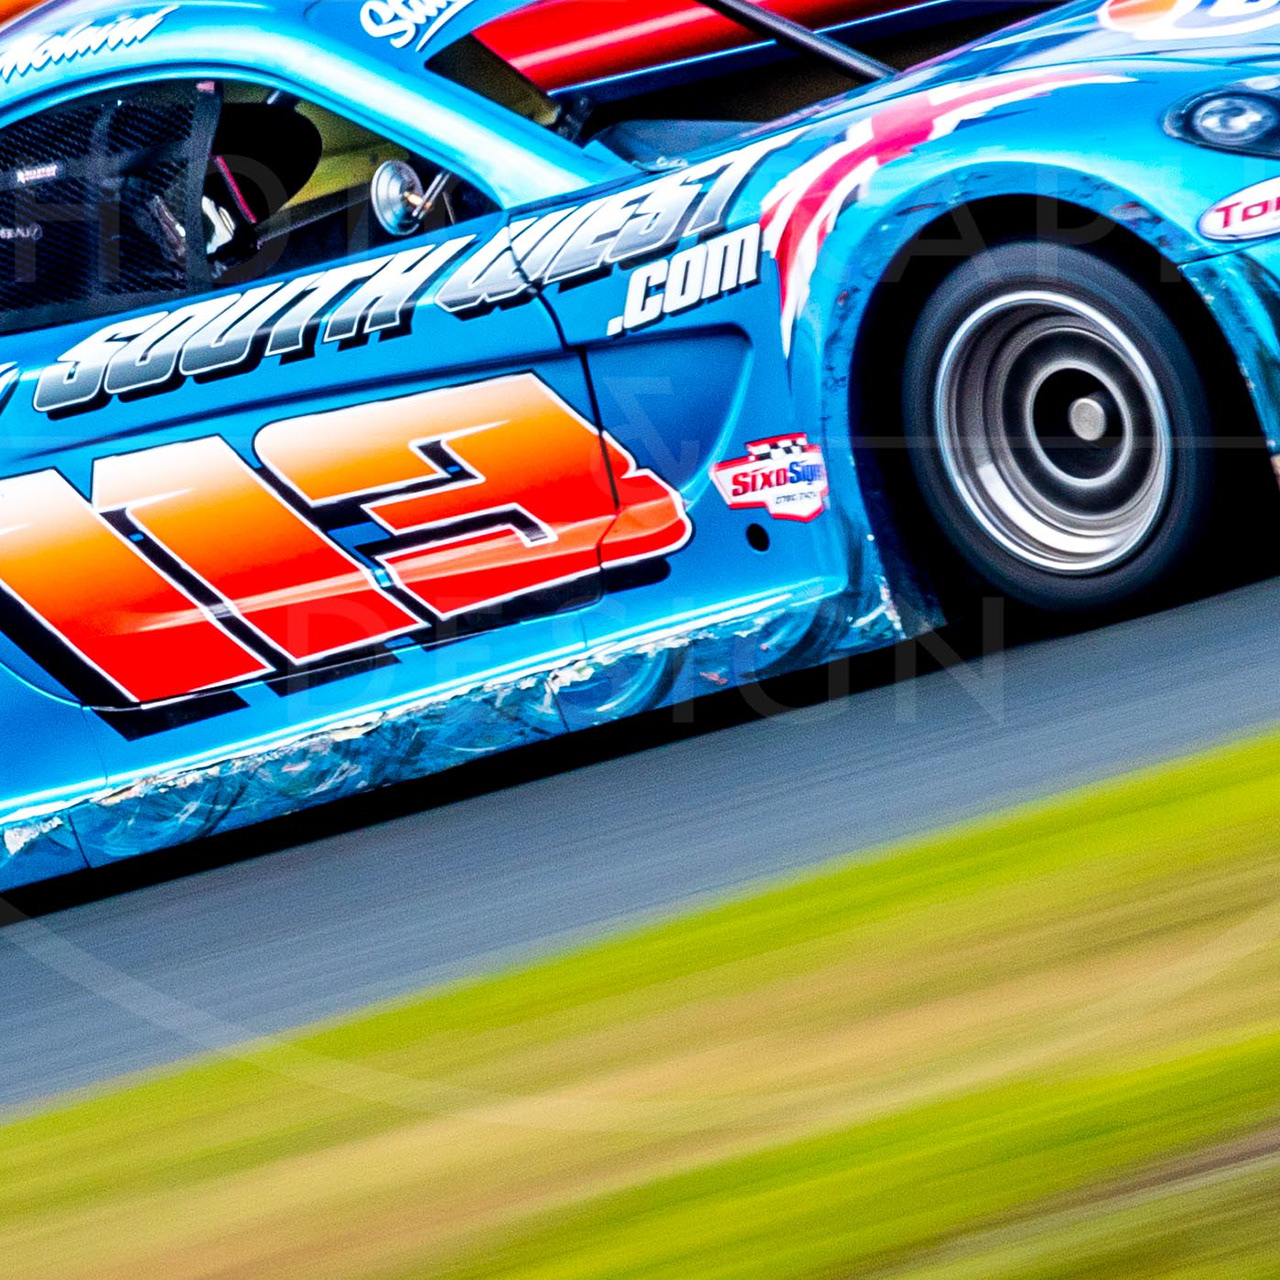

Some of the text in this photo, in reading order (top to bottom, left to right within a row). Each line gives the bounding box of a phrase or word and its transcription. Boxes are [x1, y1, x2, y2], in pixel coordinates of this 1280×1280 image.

[32, 234, 465, 414] SOUTH
[432, 125, 818, 312] WEST
[606, 222, 764, 336] .com
